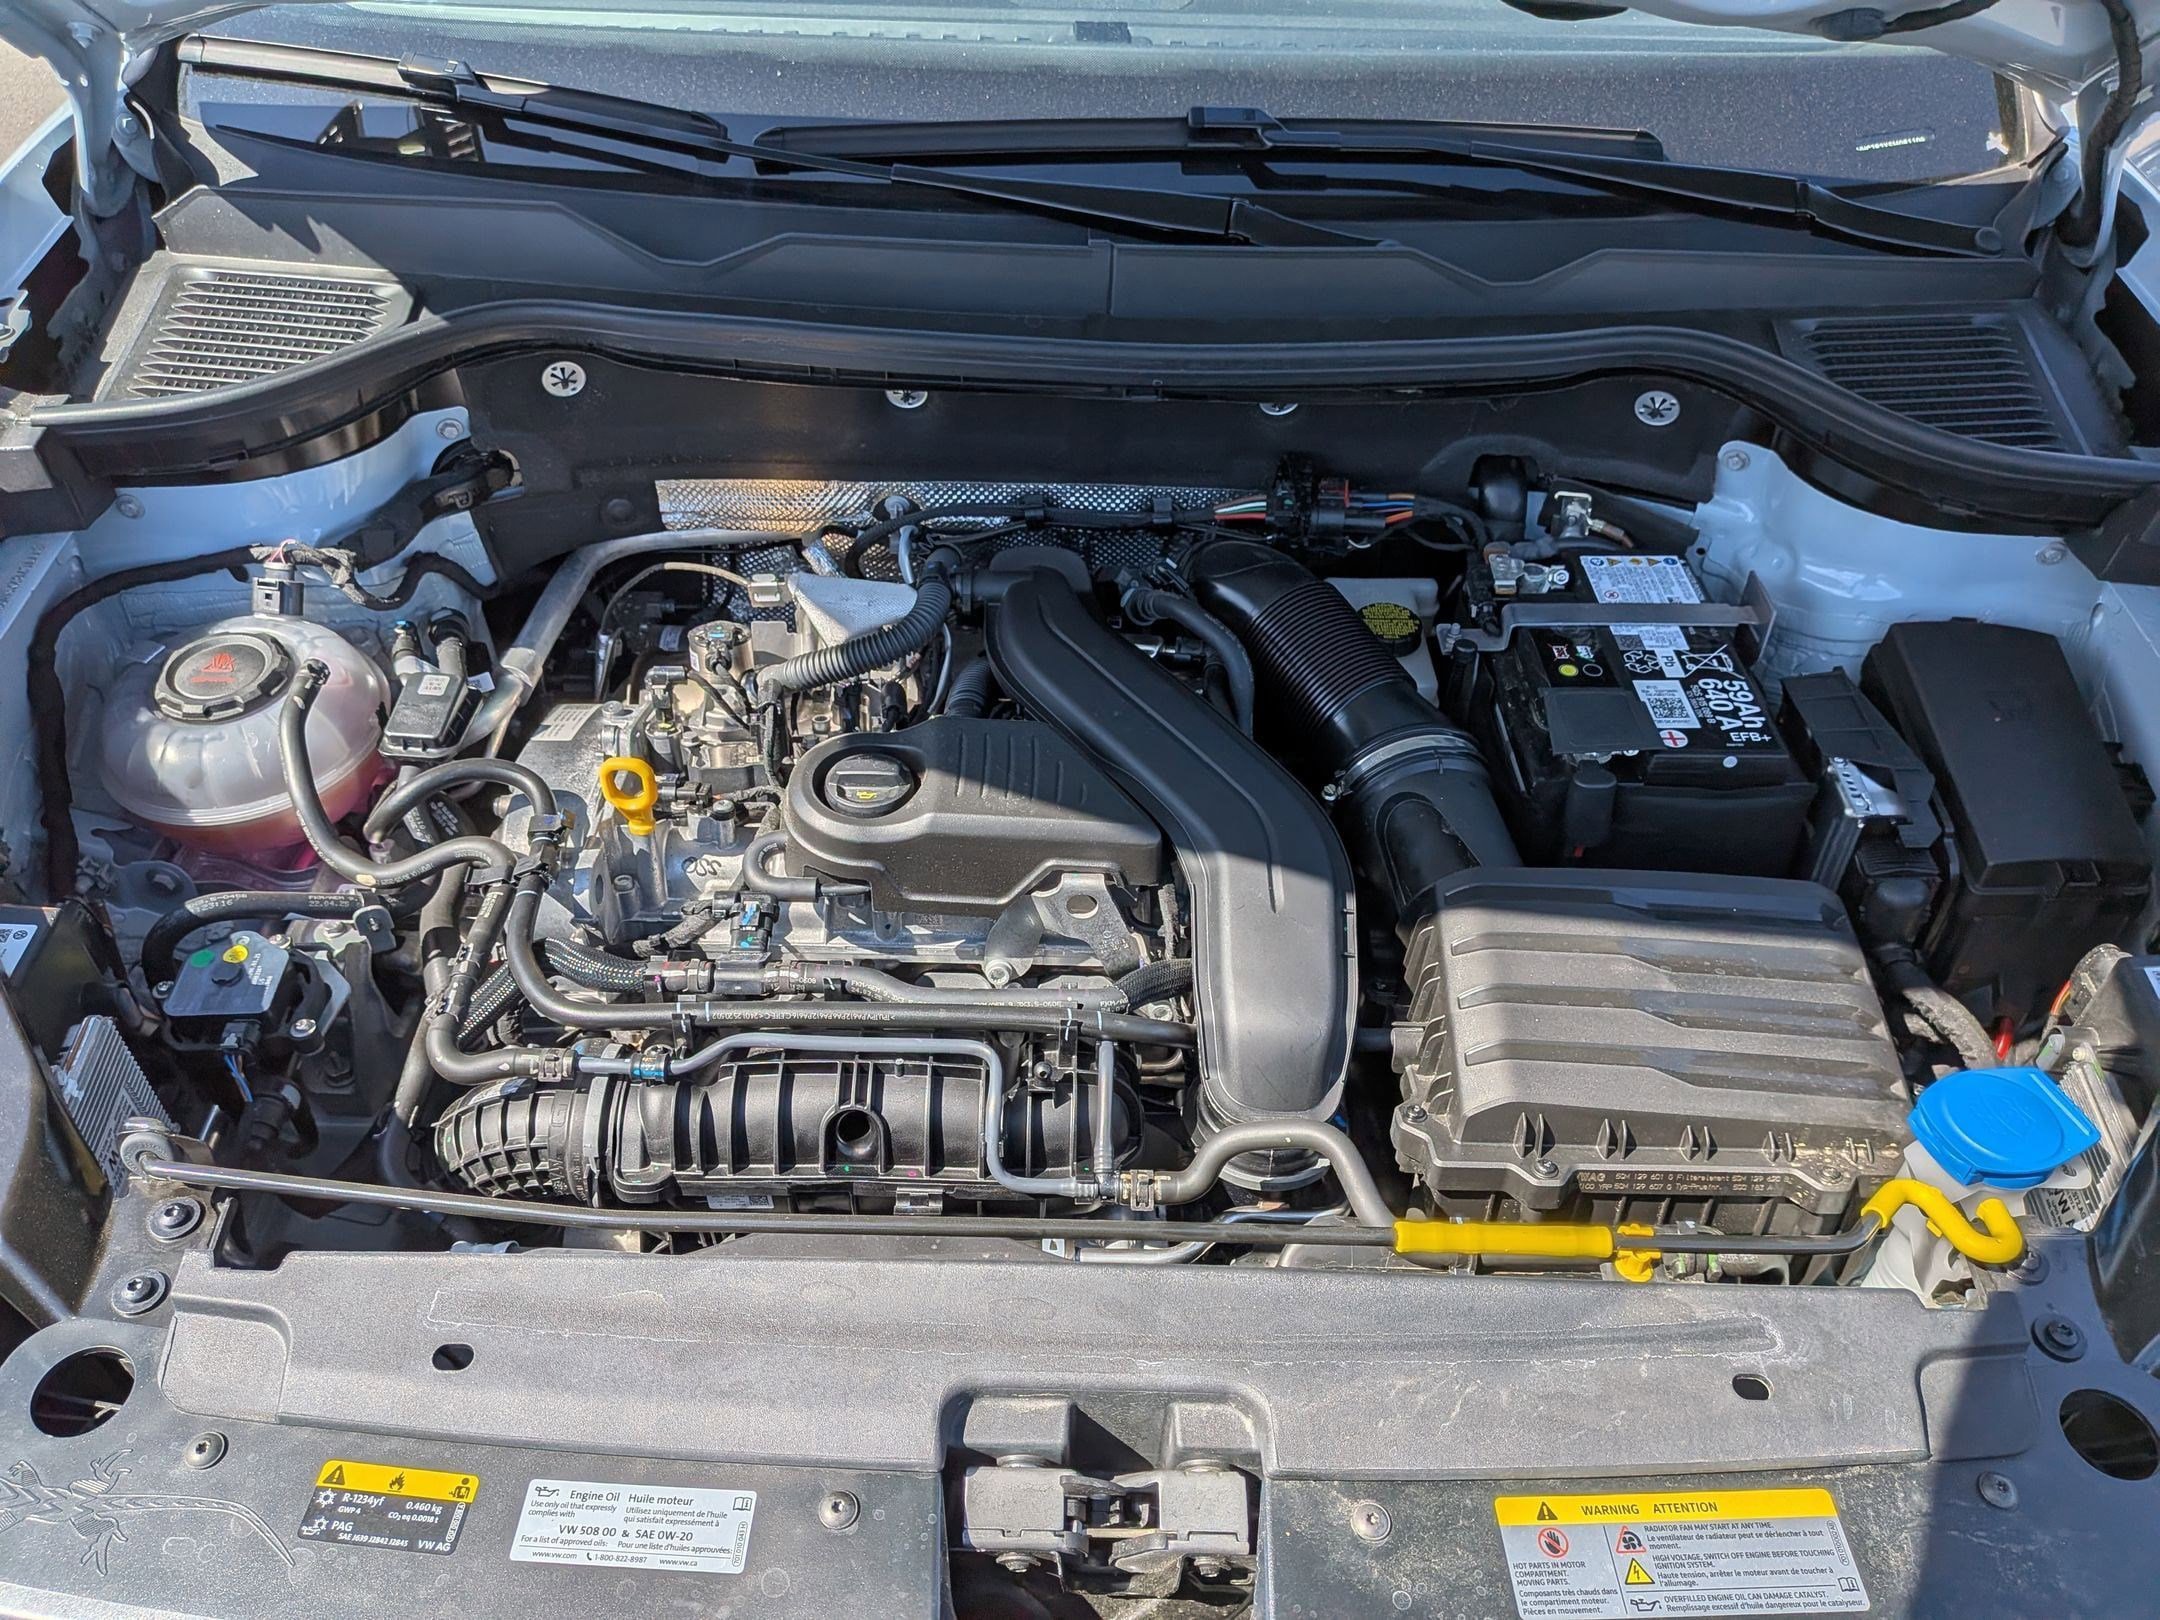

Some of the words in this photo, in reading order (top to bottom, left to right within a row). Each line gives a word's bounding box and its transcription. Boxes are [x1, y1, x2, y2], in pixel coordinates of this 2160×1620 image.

[1662, 656, 1676, 667] Pb
[1698, 679, 1734, 711] 640
[1722, 680, 1765, 728] 59Ah
[1715, 716, 1743, 730] A
[1730, 732, 1772, 742] EFB+
[570, 1490, 604, 1502] Engine
[606, 1492, 620, 1502] Oil
[628, 1494, 654, 1504] Huile
[657, 1496, 694, 1506] moteur
[342, 1493, 386, 1508] R-1234yf
[406, 1501, 431, 1511] 0.460
[432, 1504, 442, 1514] kg
[1581, 1503, 1640, 1516] WARNING
[1653, 1501, 1718, 1514] ATTENTION
[411, 1514, 434, 1523] 0.0018
[528, 1509, 558, 1518] complies
[653, 1508, 695, 1518] uniquement
[707, 1510, 728, 1519] l'huile
[331, 1521, 354, 1531] PAG
[665, 1518, 714, 1527] expressément
[559, 1525, 578, 1534] VW
[580, 1526, 600, 1536] 508
[602, 1527, 616, 1537] 00
[621, 1530, 630, 1538] &
[635, 1530, 655, 1539] SAE
[658, 1530, 693, 1541] 0W-20
[1764, 1530, 1801, 1538] déclencher
[418, 1540, 434, 1550] VW
[435, 1542, 451, 1551] AG
[664, 1543, 690, 1551] d'huiles
[691, 1545, 732, 1554] approuvées:
[532, 1551, 577, 1559] www.vw.com
[594, 1554, 647, 1563] 1-800-822-8987
[1519, 1590, 1561, 1598] Composants
[1529, 1598, 1580, 1607] compartiment
[1667, 1604, 1710, 1612] Remplissage
[1740, 1601, 1764, 1609] d'huile
[1765, 1602, 1801, 1610] dangereux
[1828, 1599, 1865, 1607] catalyseur.
